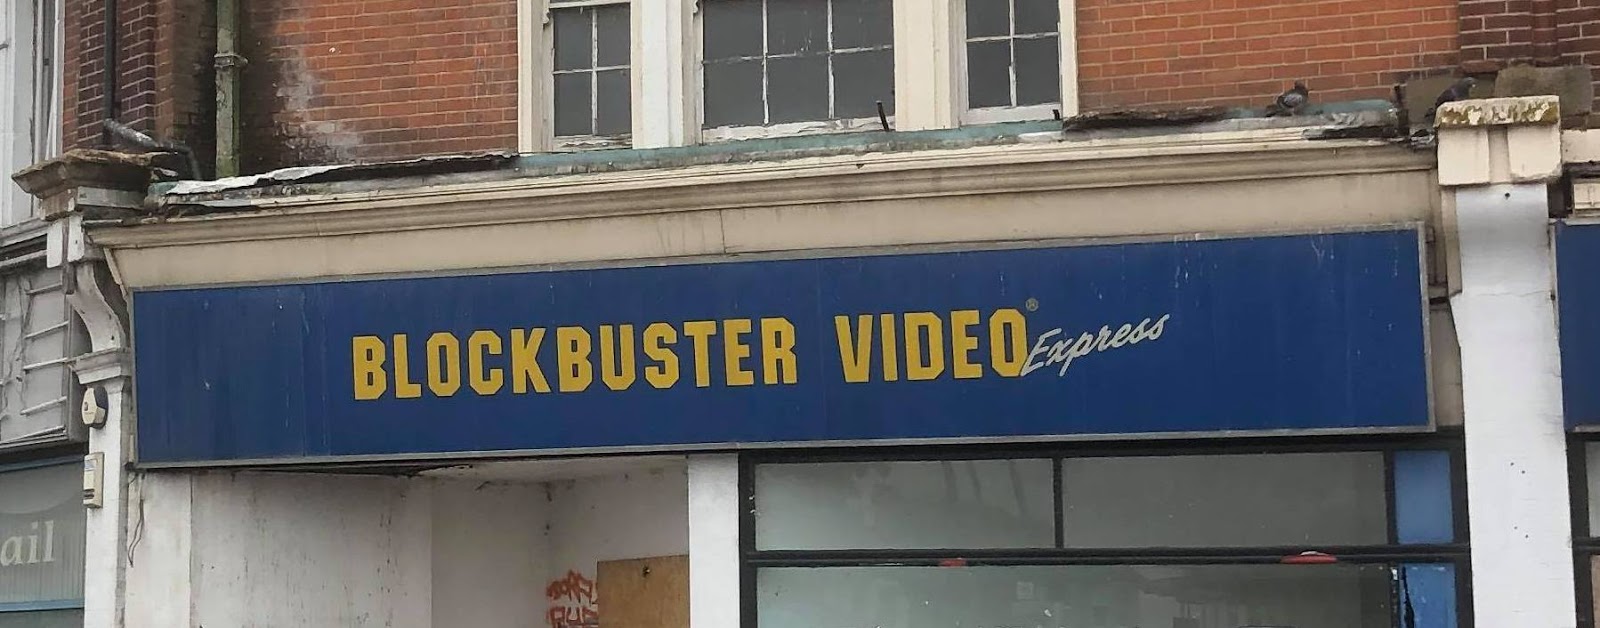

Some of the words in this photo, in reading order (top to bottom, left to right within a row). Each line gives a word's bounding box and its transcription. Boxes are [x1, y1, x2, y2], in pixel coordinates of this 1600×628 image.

[352, 317, 798, 400] BLOCKBUSTER
[834, 308, 1028, 383] VIDEO
[1020, 314, 1170, 377] Express
